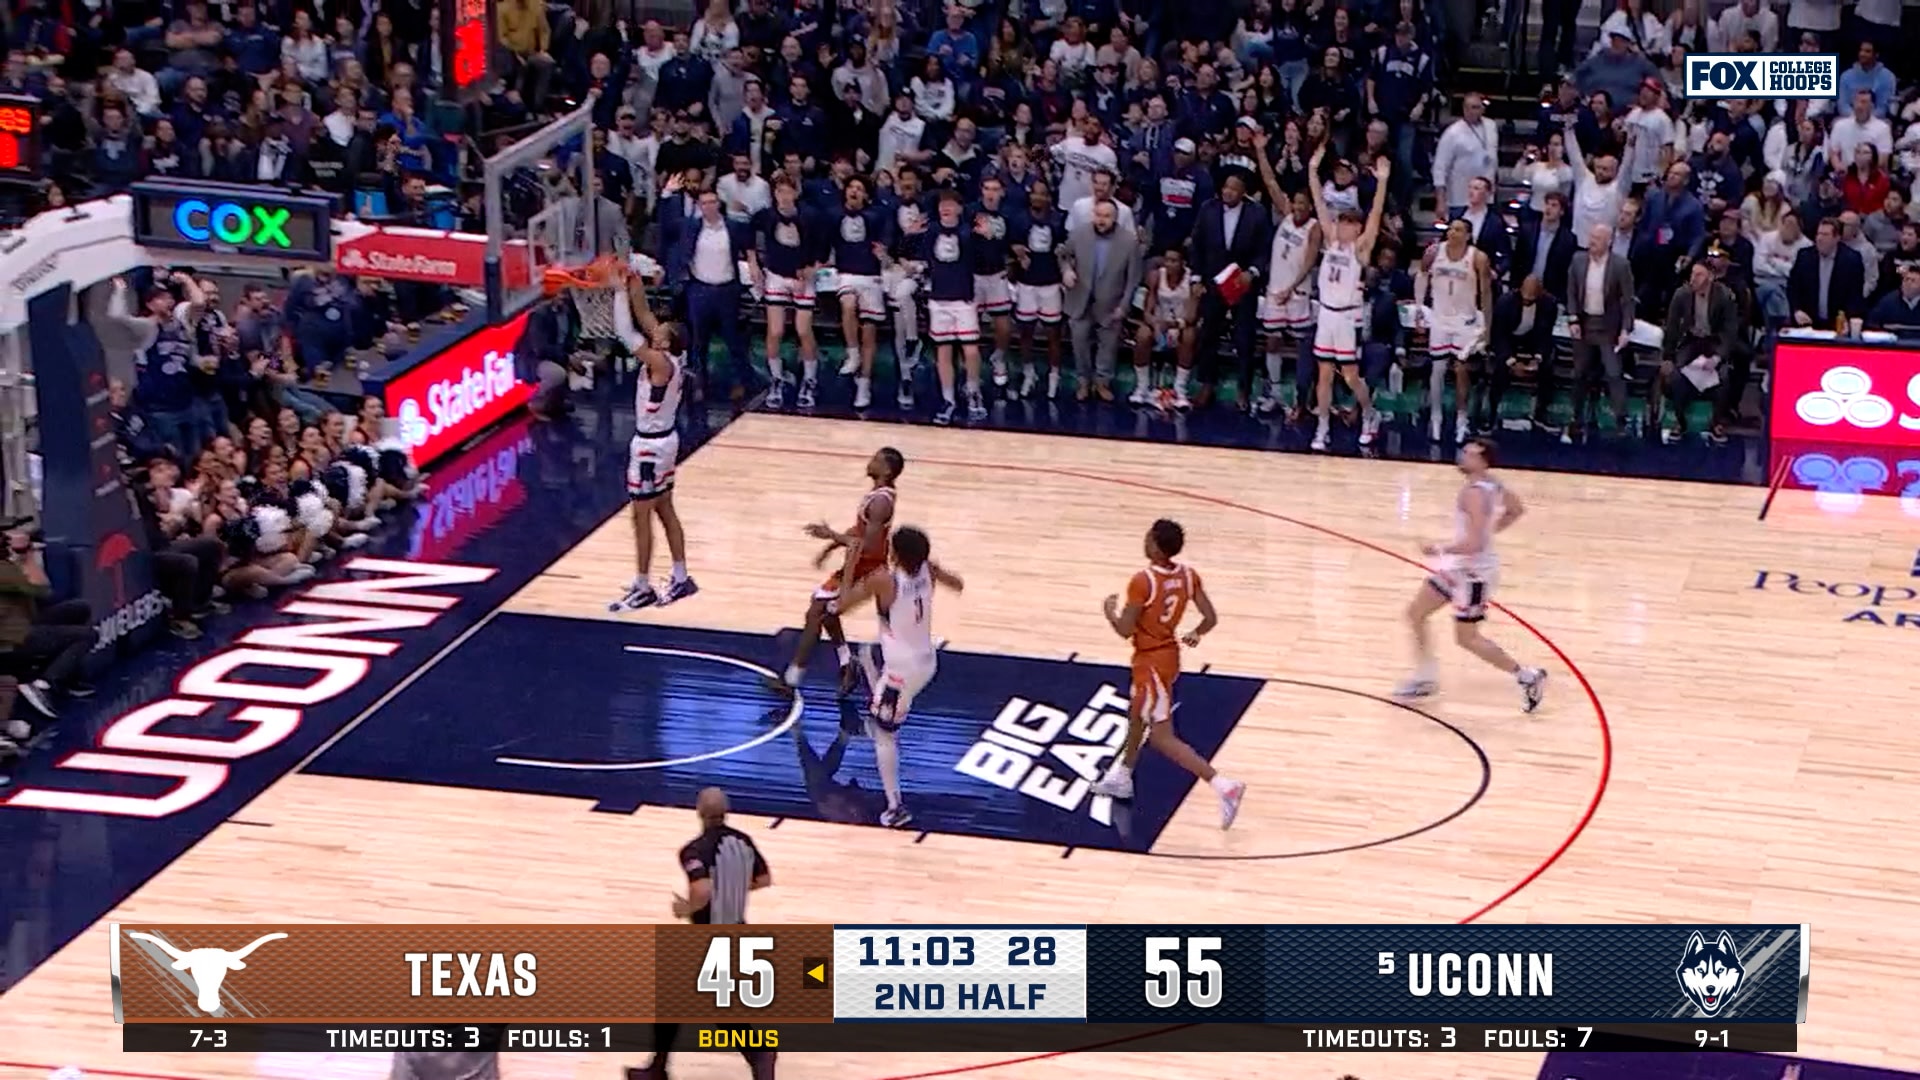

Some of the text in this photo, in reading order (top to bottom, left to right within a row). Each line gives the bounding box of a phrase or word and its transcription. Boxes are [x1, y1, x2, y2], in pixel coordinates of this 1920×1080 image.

[173, 200, 291, 247] COX
[1158, 594, 1179, 623] 3
[3, 556, 499, 818] UCONN
[952, 696, 1069, 790] BIG
[1018, 683, 1130, 812] EAST
